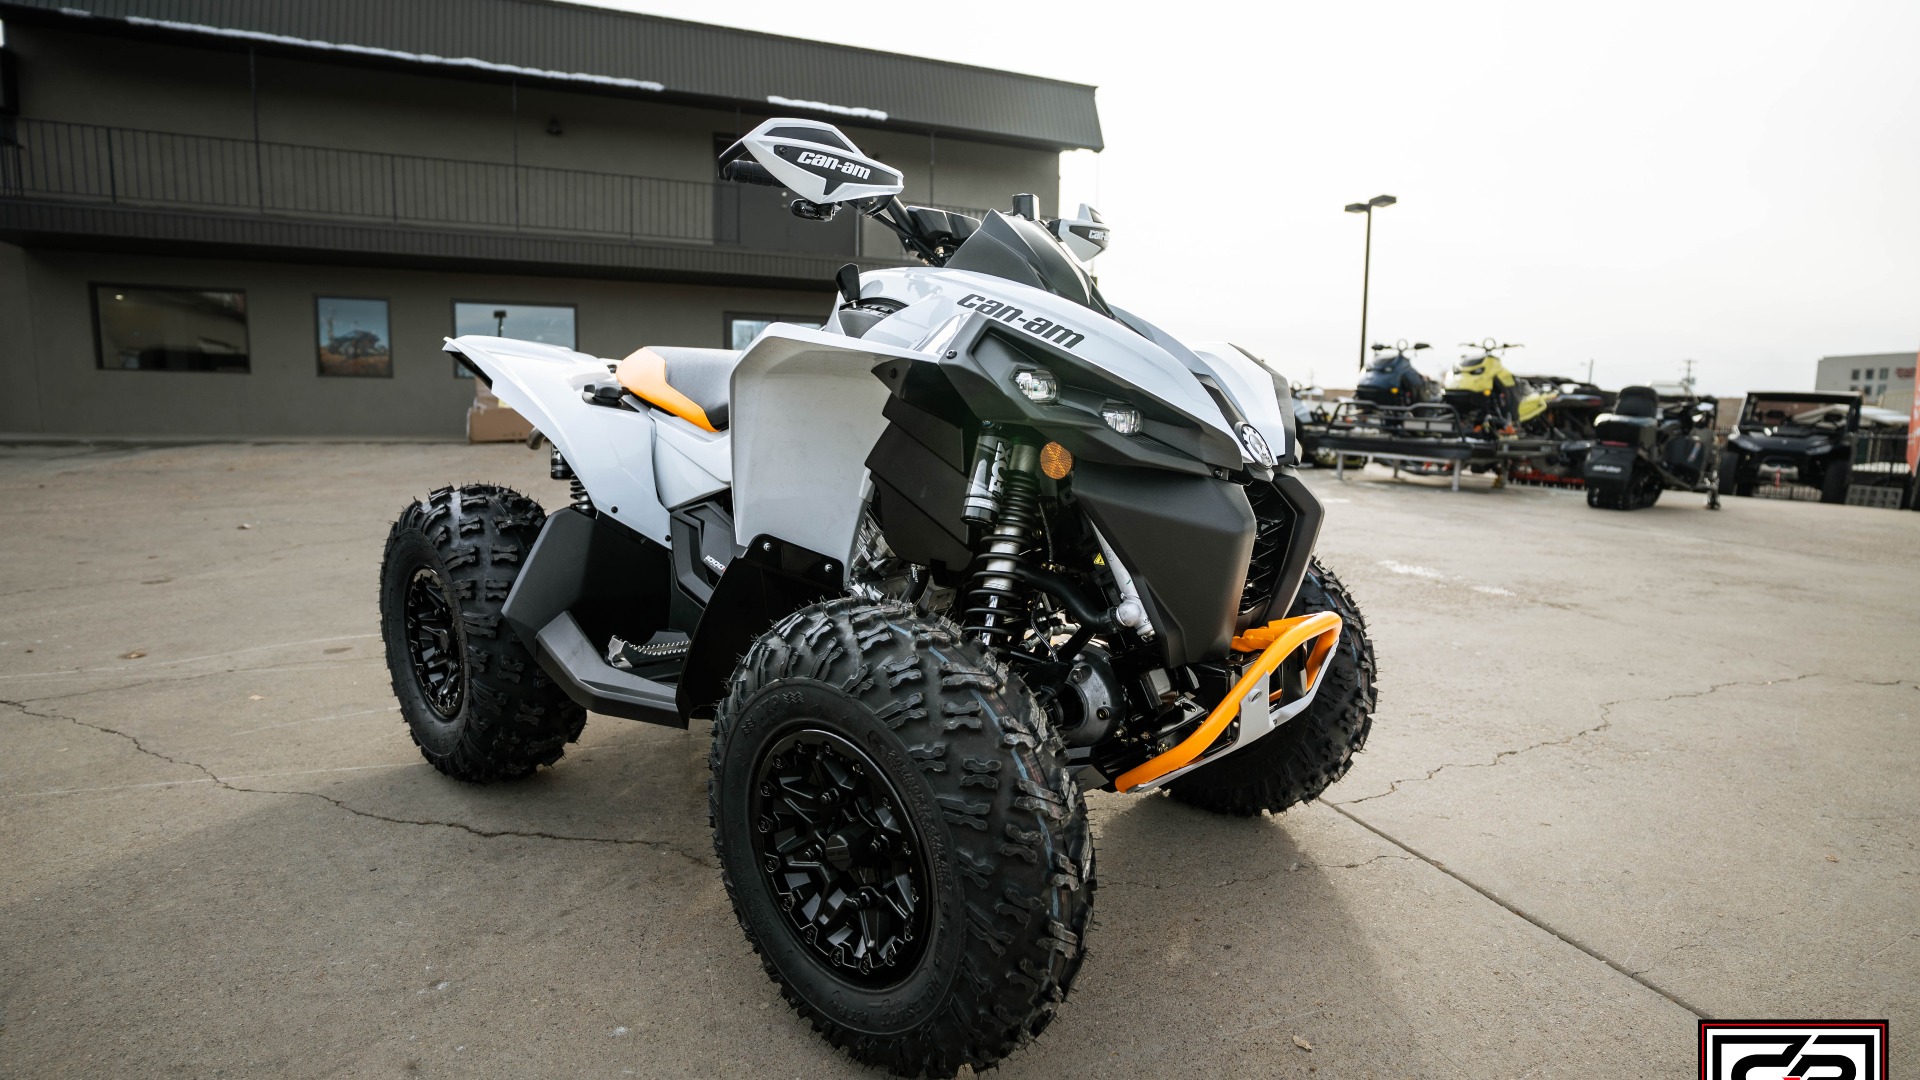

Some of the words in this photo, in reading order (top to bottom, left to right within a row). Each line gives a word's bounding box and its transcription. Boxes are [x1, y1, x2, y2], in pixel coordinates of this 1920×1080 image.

[797, 151, 871, 180] can-am
[957, 293, 1085, 349] can-am
[988, 441, 1012, 495] FOX
